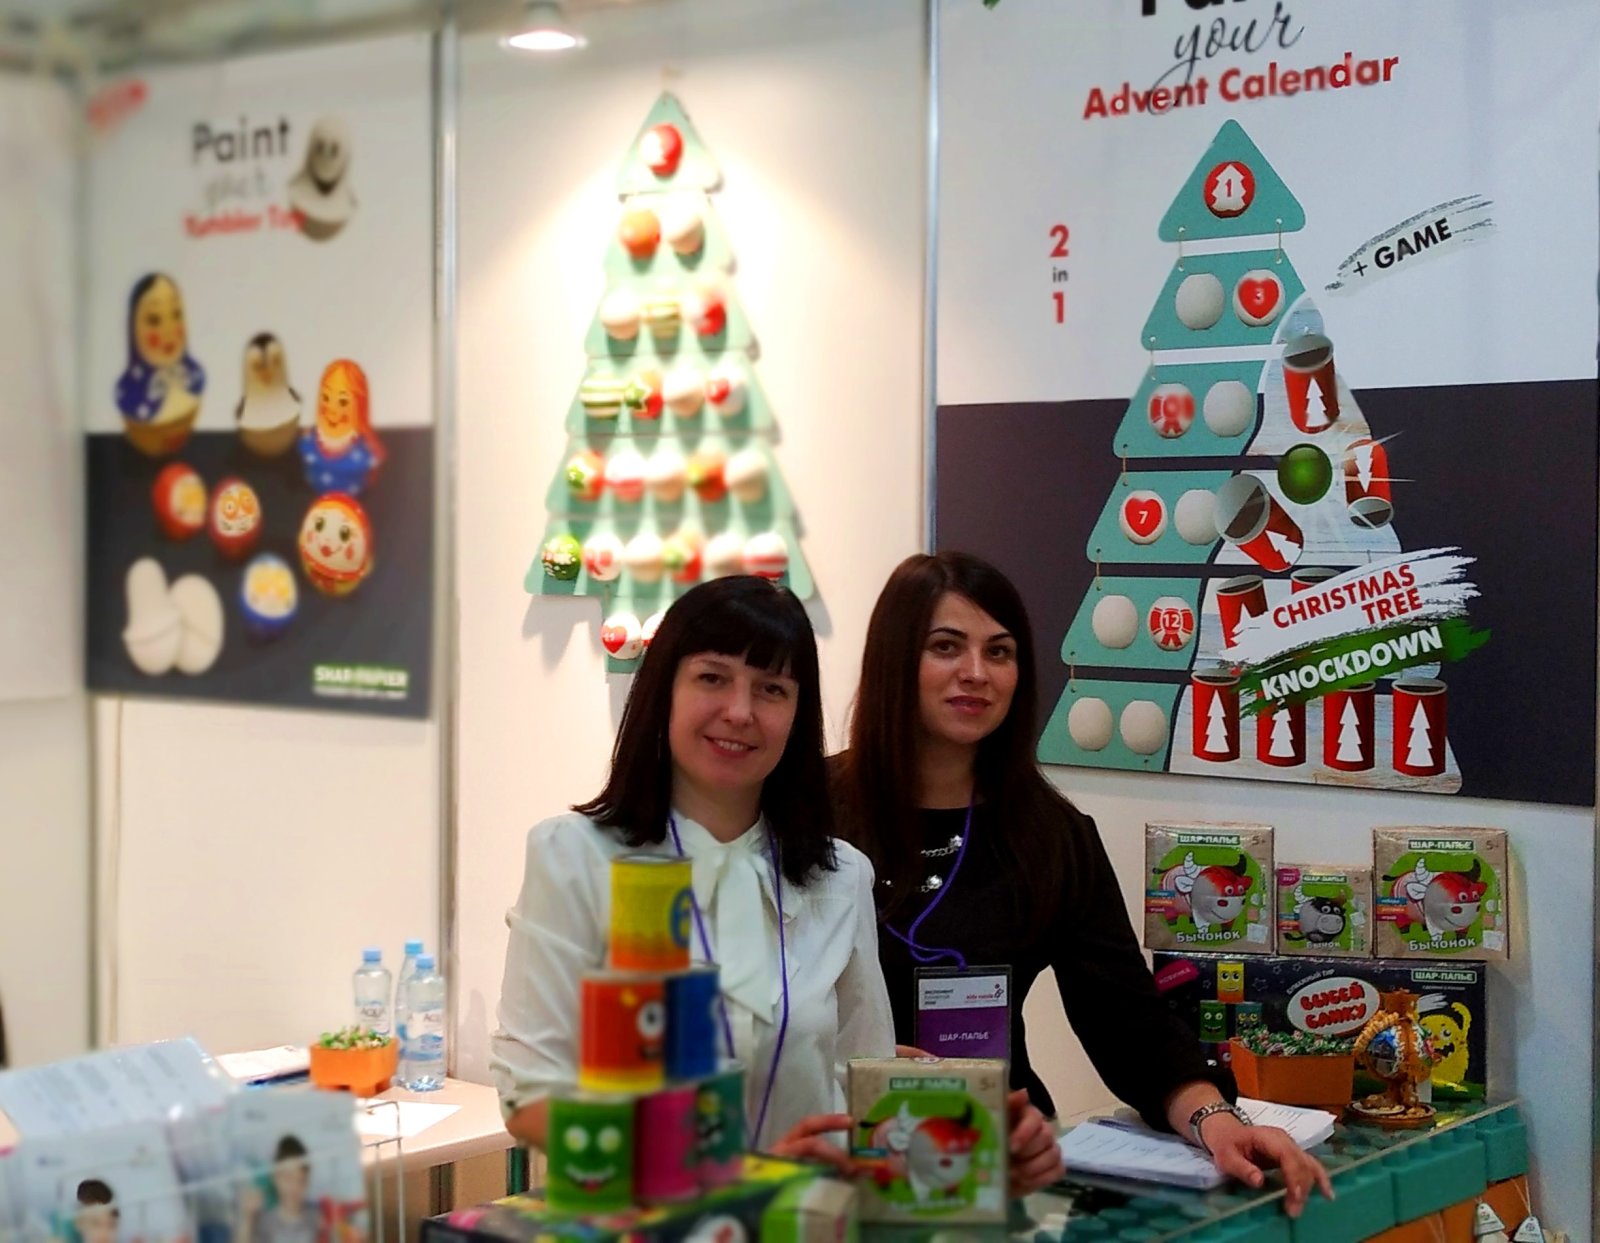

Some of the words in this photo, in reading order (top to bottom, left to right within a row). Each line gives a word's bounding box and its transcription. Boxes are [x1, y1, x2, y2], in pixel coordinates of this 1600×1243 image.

[1146, 2, 1305, 112] your
[1083, 77, 1210, 121] Advent
[1219, 51, 1400, 102] Calendar
[191, 116, 290, 166] Paint
[1225, 178, 1233, 198] 1
[1049, 224, 1070, 258] 2
[1373, 217, 1453, 269] GAME
[1052, 265, 1069, 283] in
[1052, 291, 1065, 324] 1
[1138, 510, 1149, 525] 7
[1272, 564, 1416, 629] CHRISTMAS
[1361, 586, 1424, 625] TREE
[1163, 613, 1182, 628] 12
[1260, 625, 1444, 701] KNOCKDOWN
[1415, 971, 1474, 981] ШАР-ПАПЬЕ
[938, 1032, 989, 1042] ШАР-ПАПЬЕ
